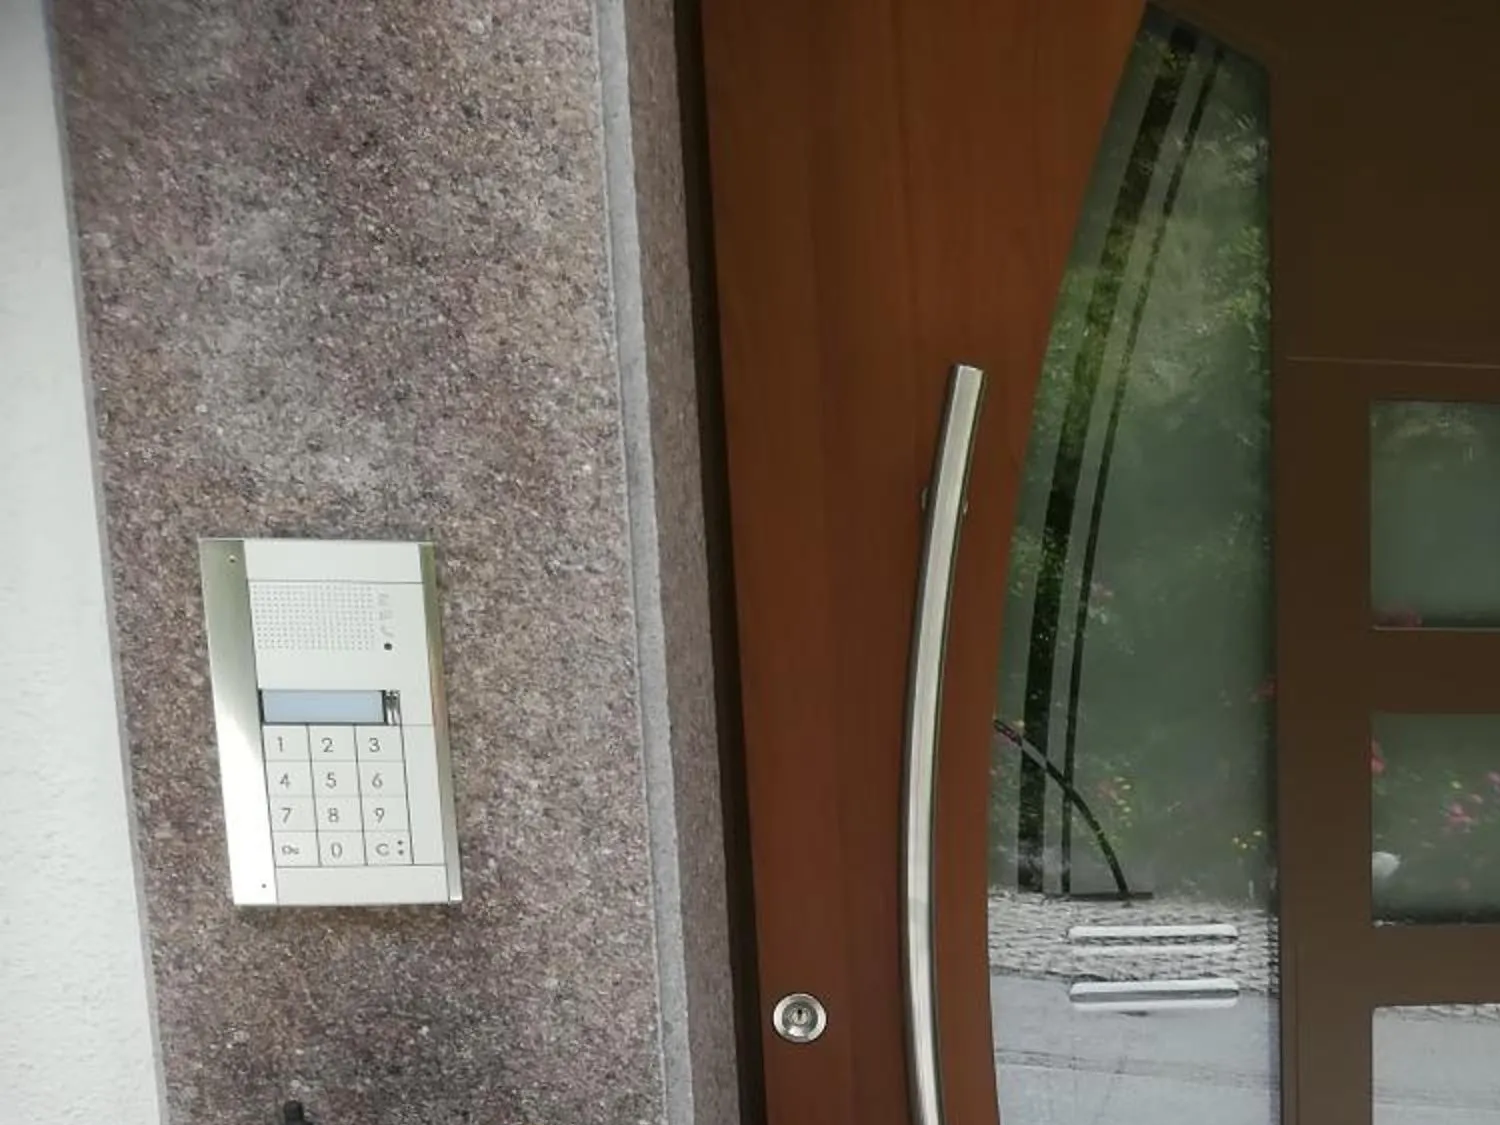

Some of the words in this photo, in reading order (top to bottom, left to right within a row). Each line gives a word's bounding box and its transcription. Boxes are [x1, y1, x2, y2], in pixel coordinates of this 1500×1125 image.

[276, 736, 284, 753] 1
[321, 737, 334, 753] 2
[368, 737, 381, 753] 3
[279, 773, 291, 789] 4
[325, 772, 337, 789] 5
[371, 772, 383, 789] 6
[280, 807, 292, 824] 7
[328, 807, 339, 823] 8
[374, 807, 385, 823] 9
[330, 842, 343, 859] 0
[375, 843, 390, 857] C
